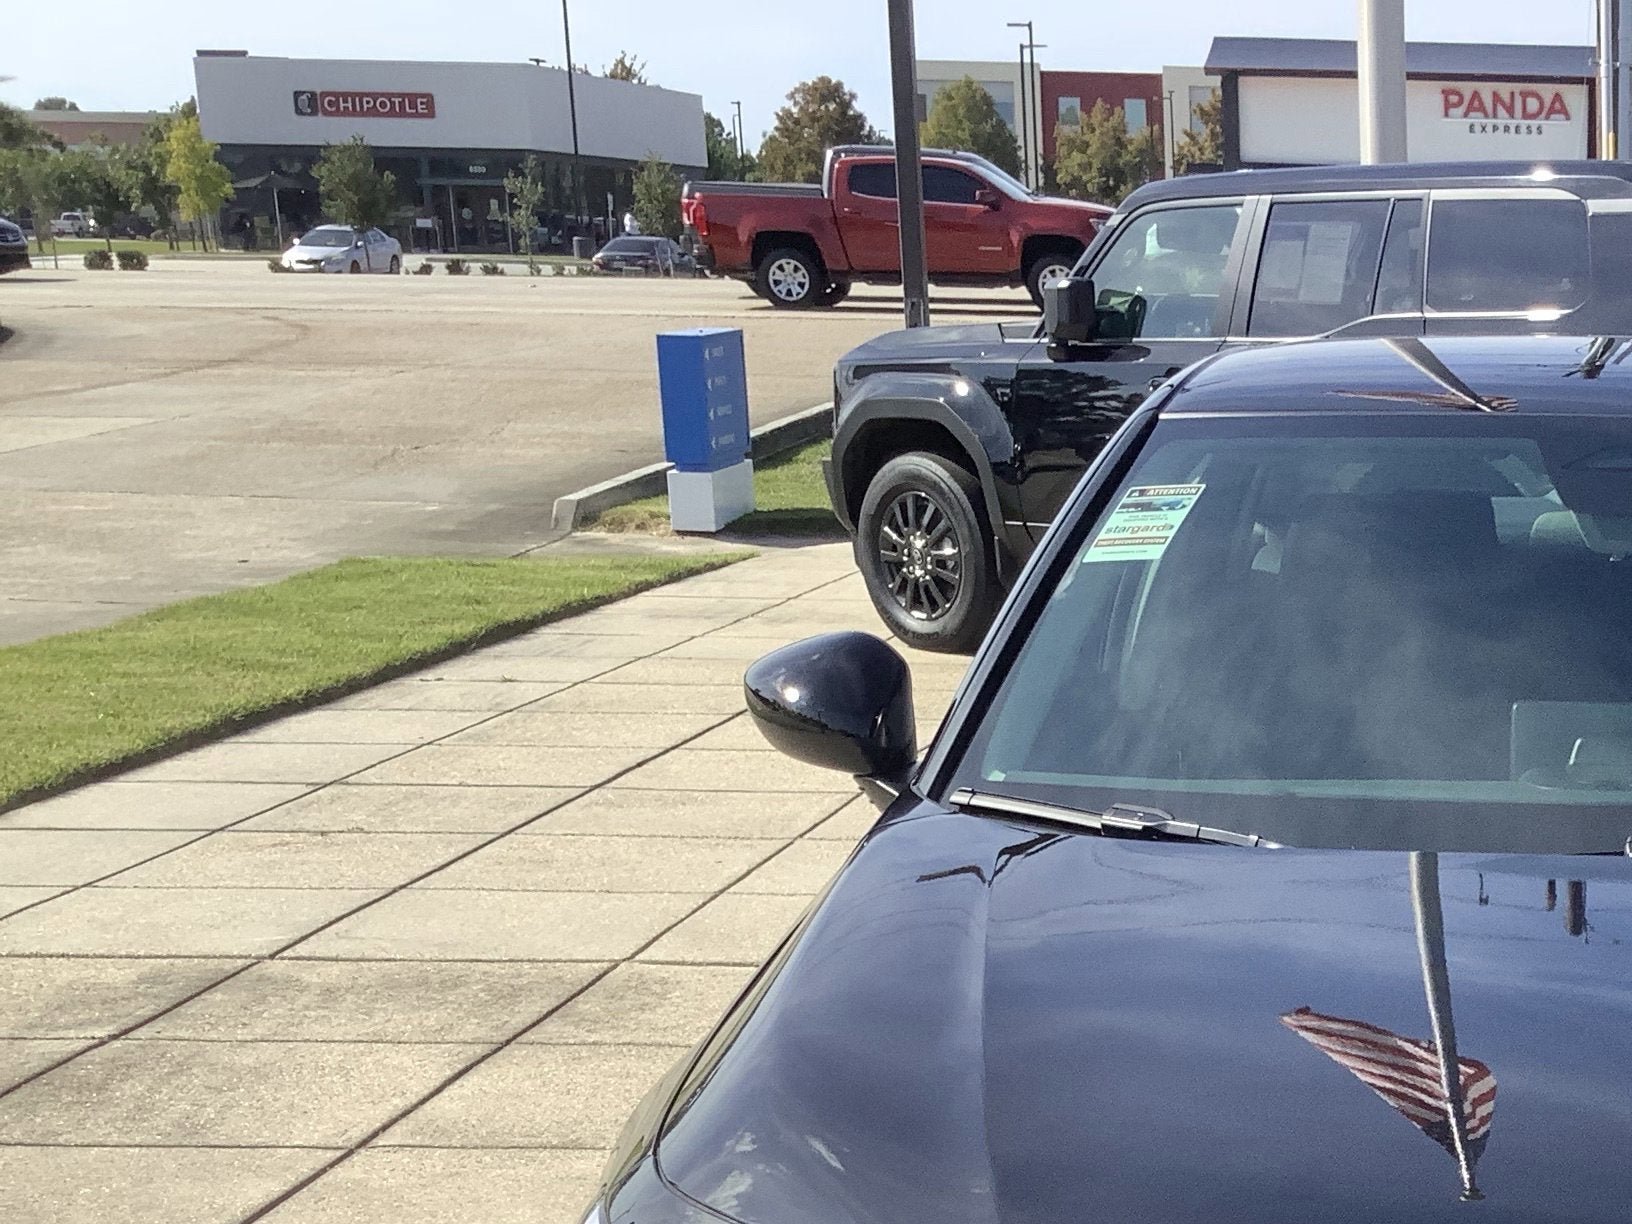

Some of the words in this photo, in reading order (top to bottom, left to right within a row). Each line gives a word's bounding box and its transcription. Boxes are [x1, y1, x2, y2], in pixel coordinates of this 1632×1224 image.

[323, 96, 429, 113] CHIPOTLE
[1441, 87, 1571, 121] PANDA
[1468, 123, 1543, 135] EXPRESS
[1146, 487, 1199, 496] ATTENTION
